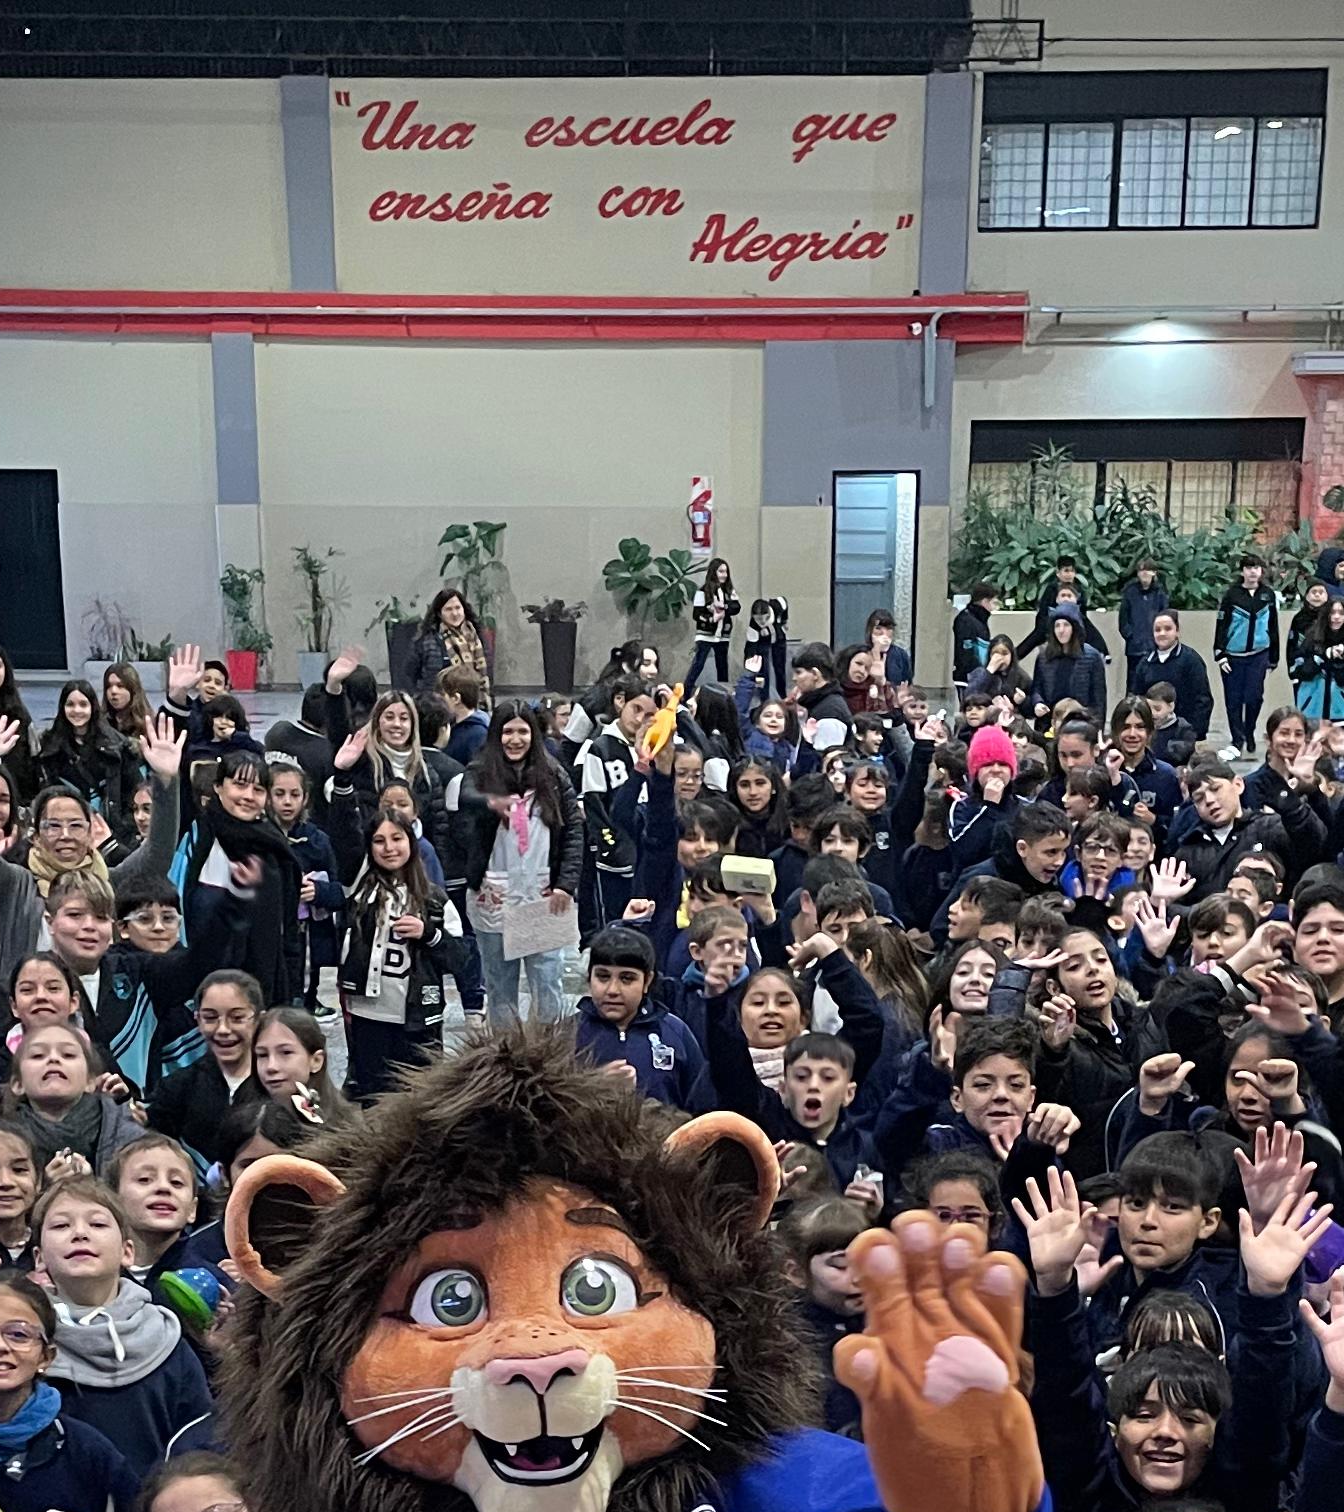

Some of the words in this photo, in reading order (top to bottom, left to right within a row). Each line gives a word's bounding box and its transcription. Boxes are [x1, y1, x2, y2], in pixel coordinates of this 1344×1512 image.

[525, 99, 733, 148] escuela
[793, 110, 897, 162] que
[367, 182, 552, 223] enseña
[598, 185, 684, 219] con
[605, 759, 629, 790] B
